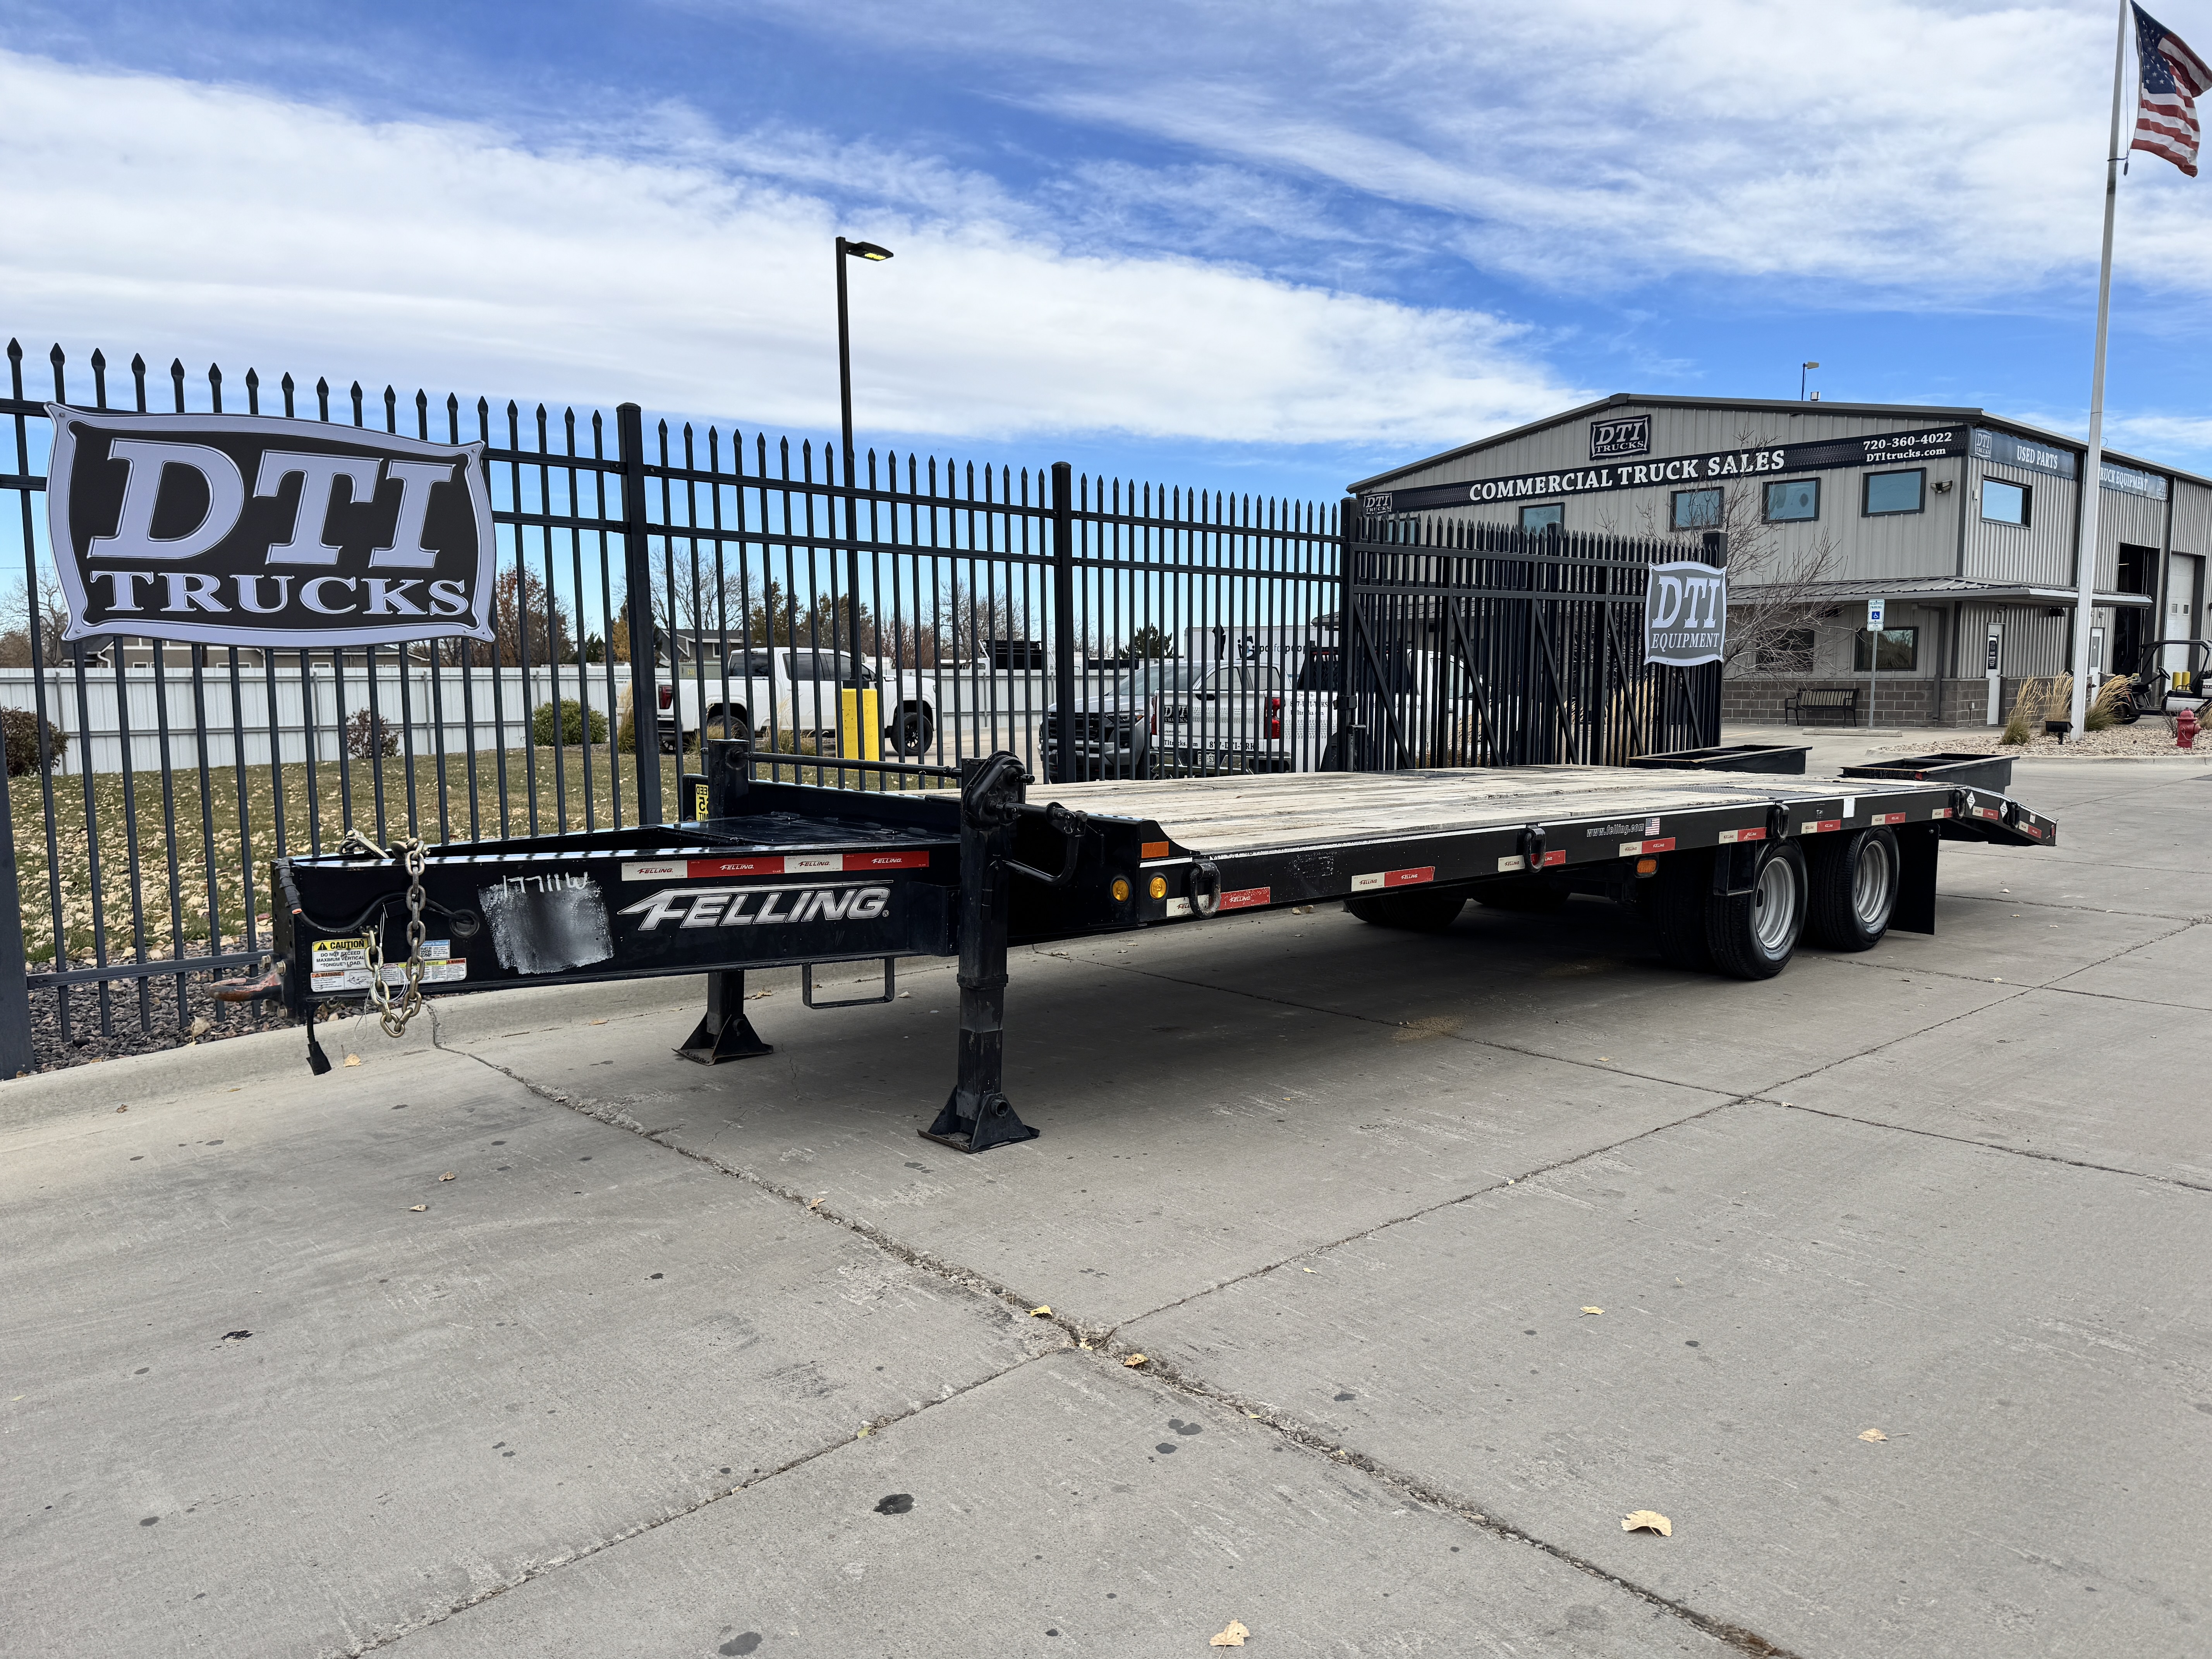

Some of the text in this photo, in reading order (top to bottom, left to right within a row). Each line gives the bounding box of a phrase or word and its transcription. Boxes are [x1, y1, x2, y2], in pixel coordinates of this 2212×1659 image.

[1596, 421, 1642, 445] DTI
[1863, 432, 1952, 450] 720-360-4022
[1977, 433, 1991, 448] DTI
[1595, 440, 1644, 453] TRUCKS
[1866, 447, 1946, 462] DTItrucks.com
[2017, 445, 2057, 469] USED PARTS
[1470, 450, 1784, 501] COMMERCIAL TRUCK SALES
[2100, 467, 2148, 491] RUCK EQUIPMENT
[86, 438, 457, 568] DTI
[1366, 496, 1390, 508] DTI
[89, 570, 469, 616] TRUCKS
[1651, 575, 1721, 629] DTI
[1650, 632, 1720, 653] EQUIPMENT
[1164, 706, 1187, 717] DI
[1587, 823, 1644, 837] www.felling.com
[330, 940, 364, 949] CAUTION
